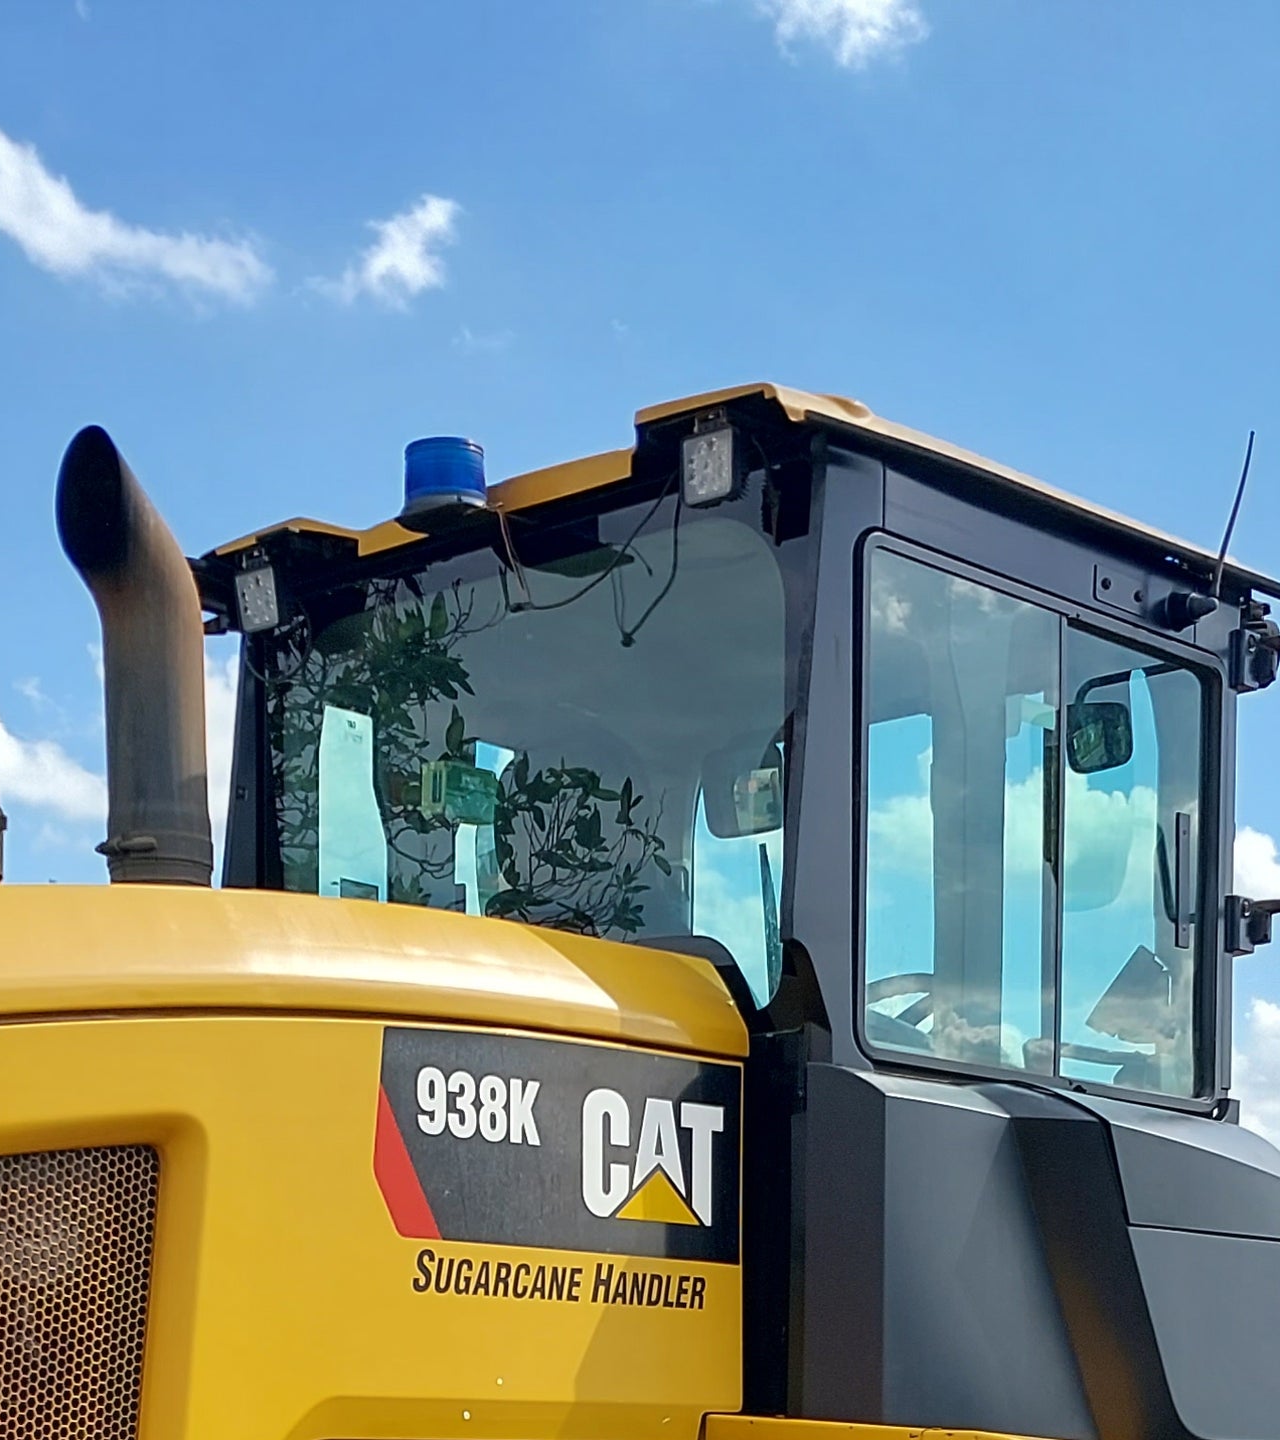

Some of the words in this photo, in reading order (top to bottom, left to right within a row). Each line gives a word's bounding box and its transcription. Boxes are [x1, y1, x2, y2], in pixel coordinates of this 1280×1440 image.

[415, 1066, 542, 1147] 938K
[581, 1088, 725, 1227] CAT
[412, 1248, 583, 1303] SUGARCANE
[591, 1262, 707, 1311] HANDLER
